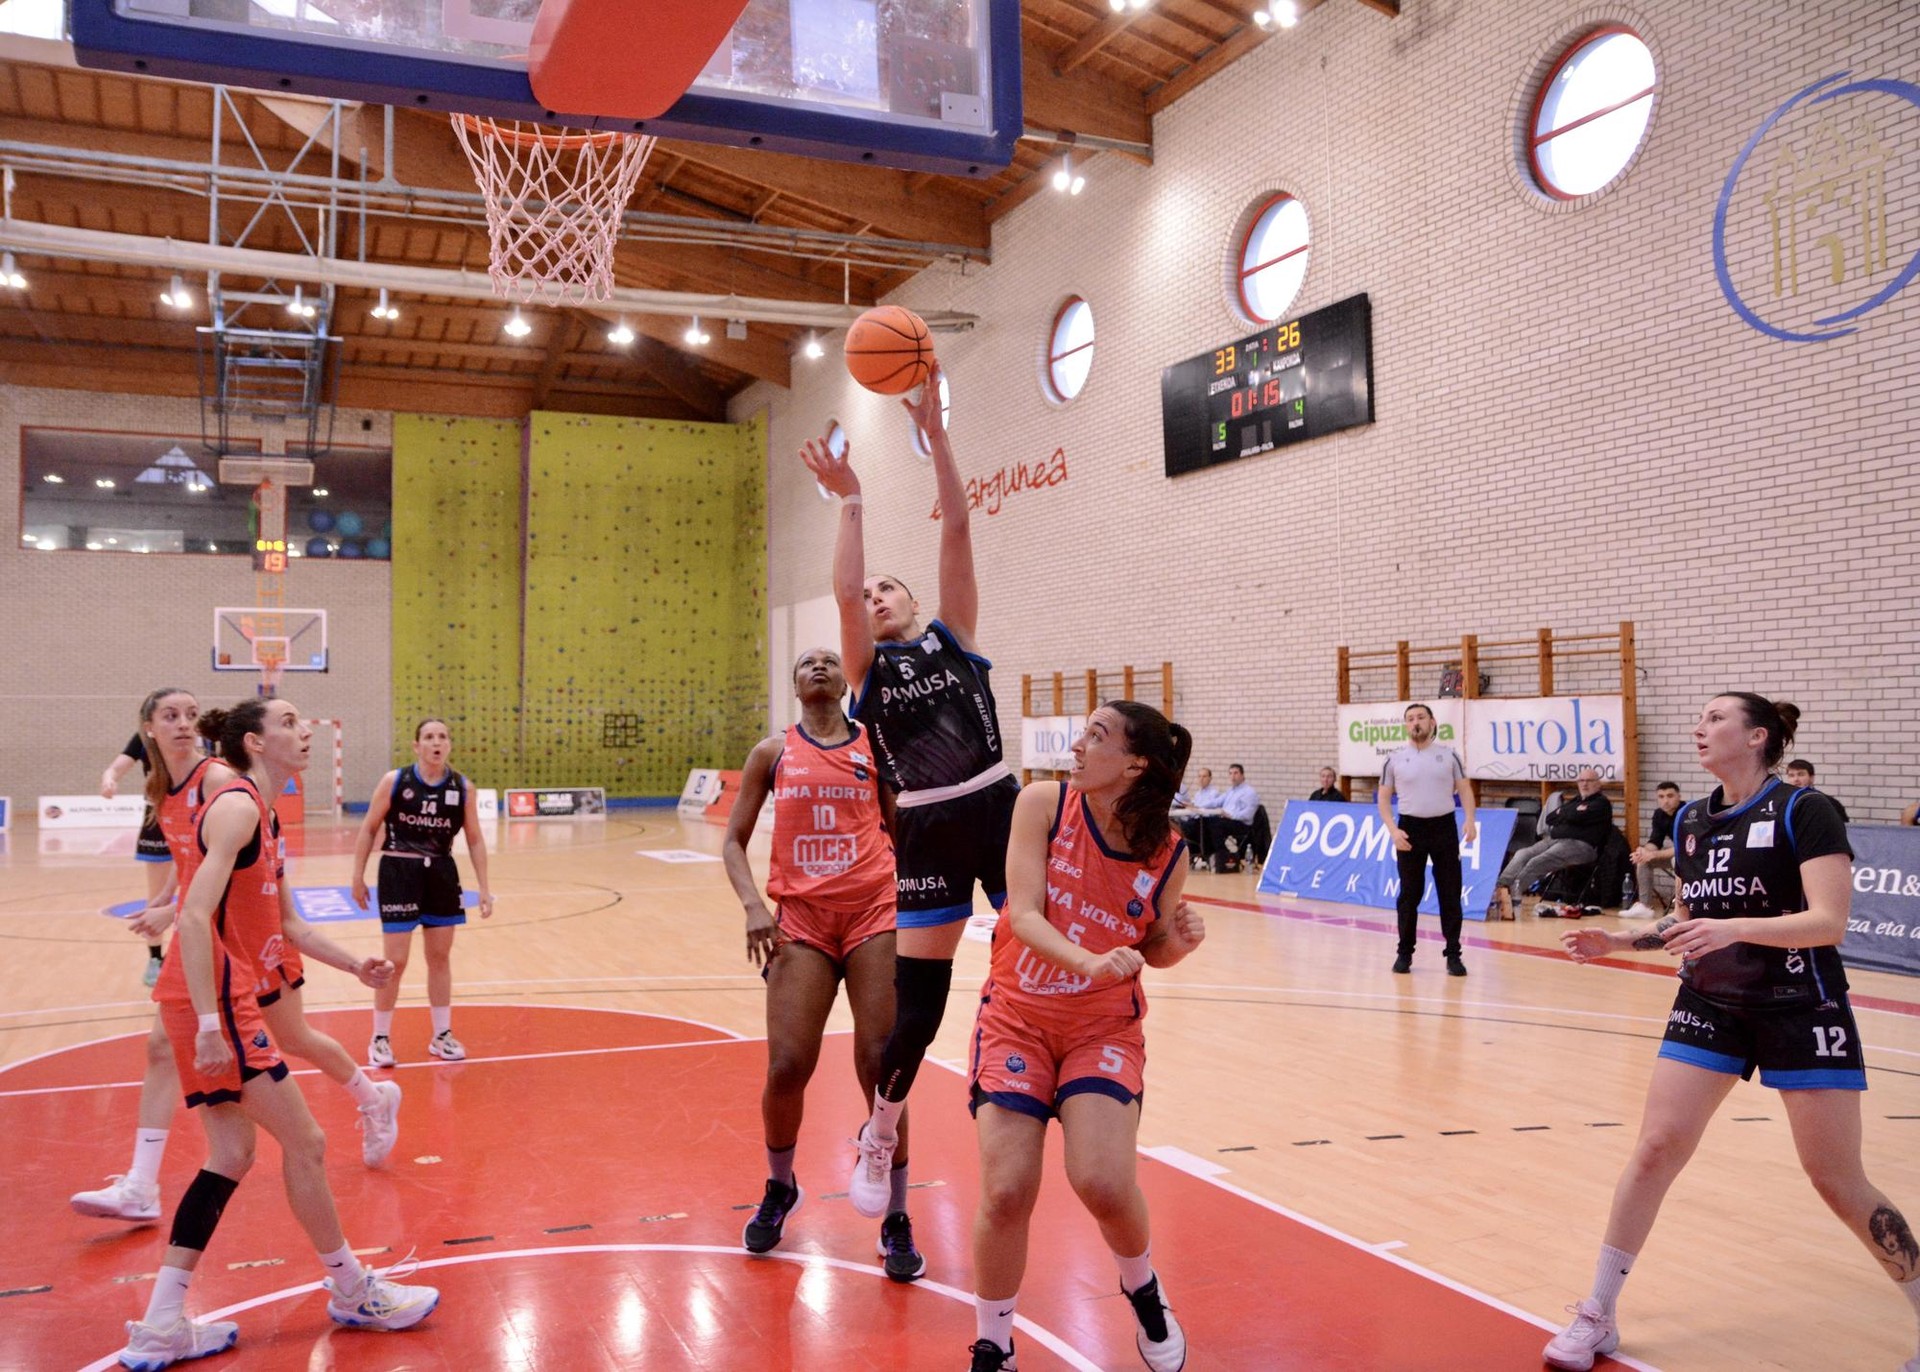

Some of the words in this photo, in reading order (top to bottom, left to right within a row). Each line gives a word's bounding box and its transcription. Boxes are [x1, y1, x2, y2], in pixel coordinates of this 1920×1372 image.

[1278, 321, 1300, 351] 26
[1216, 346, 1235, 375] 33
[1231, 378, 1280, 417] 01:15
[1295, 399, 1303, 415] 4
[1219, 422, 1227, 440] 5
[899, 662, 916, 680] 5
[1489, 699, 1616, 755] urola
[399, 812, 452, 828] DOMUSA
[420, 800, 437, 815] 14
[812, 805, 836, 830] 10
[1291, 812, 1482, 870] DOMA
[1705, 848, 1731, 873] 12
[1682, 876, 1767, 900] DOMUSA
[1066, 922, 1086, 946] 5
[1875, 921, 1906, 938] eta
[1812, 1026, 1847, 1057] 12
[1098, 1045, 1126, 1073] 5
